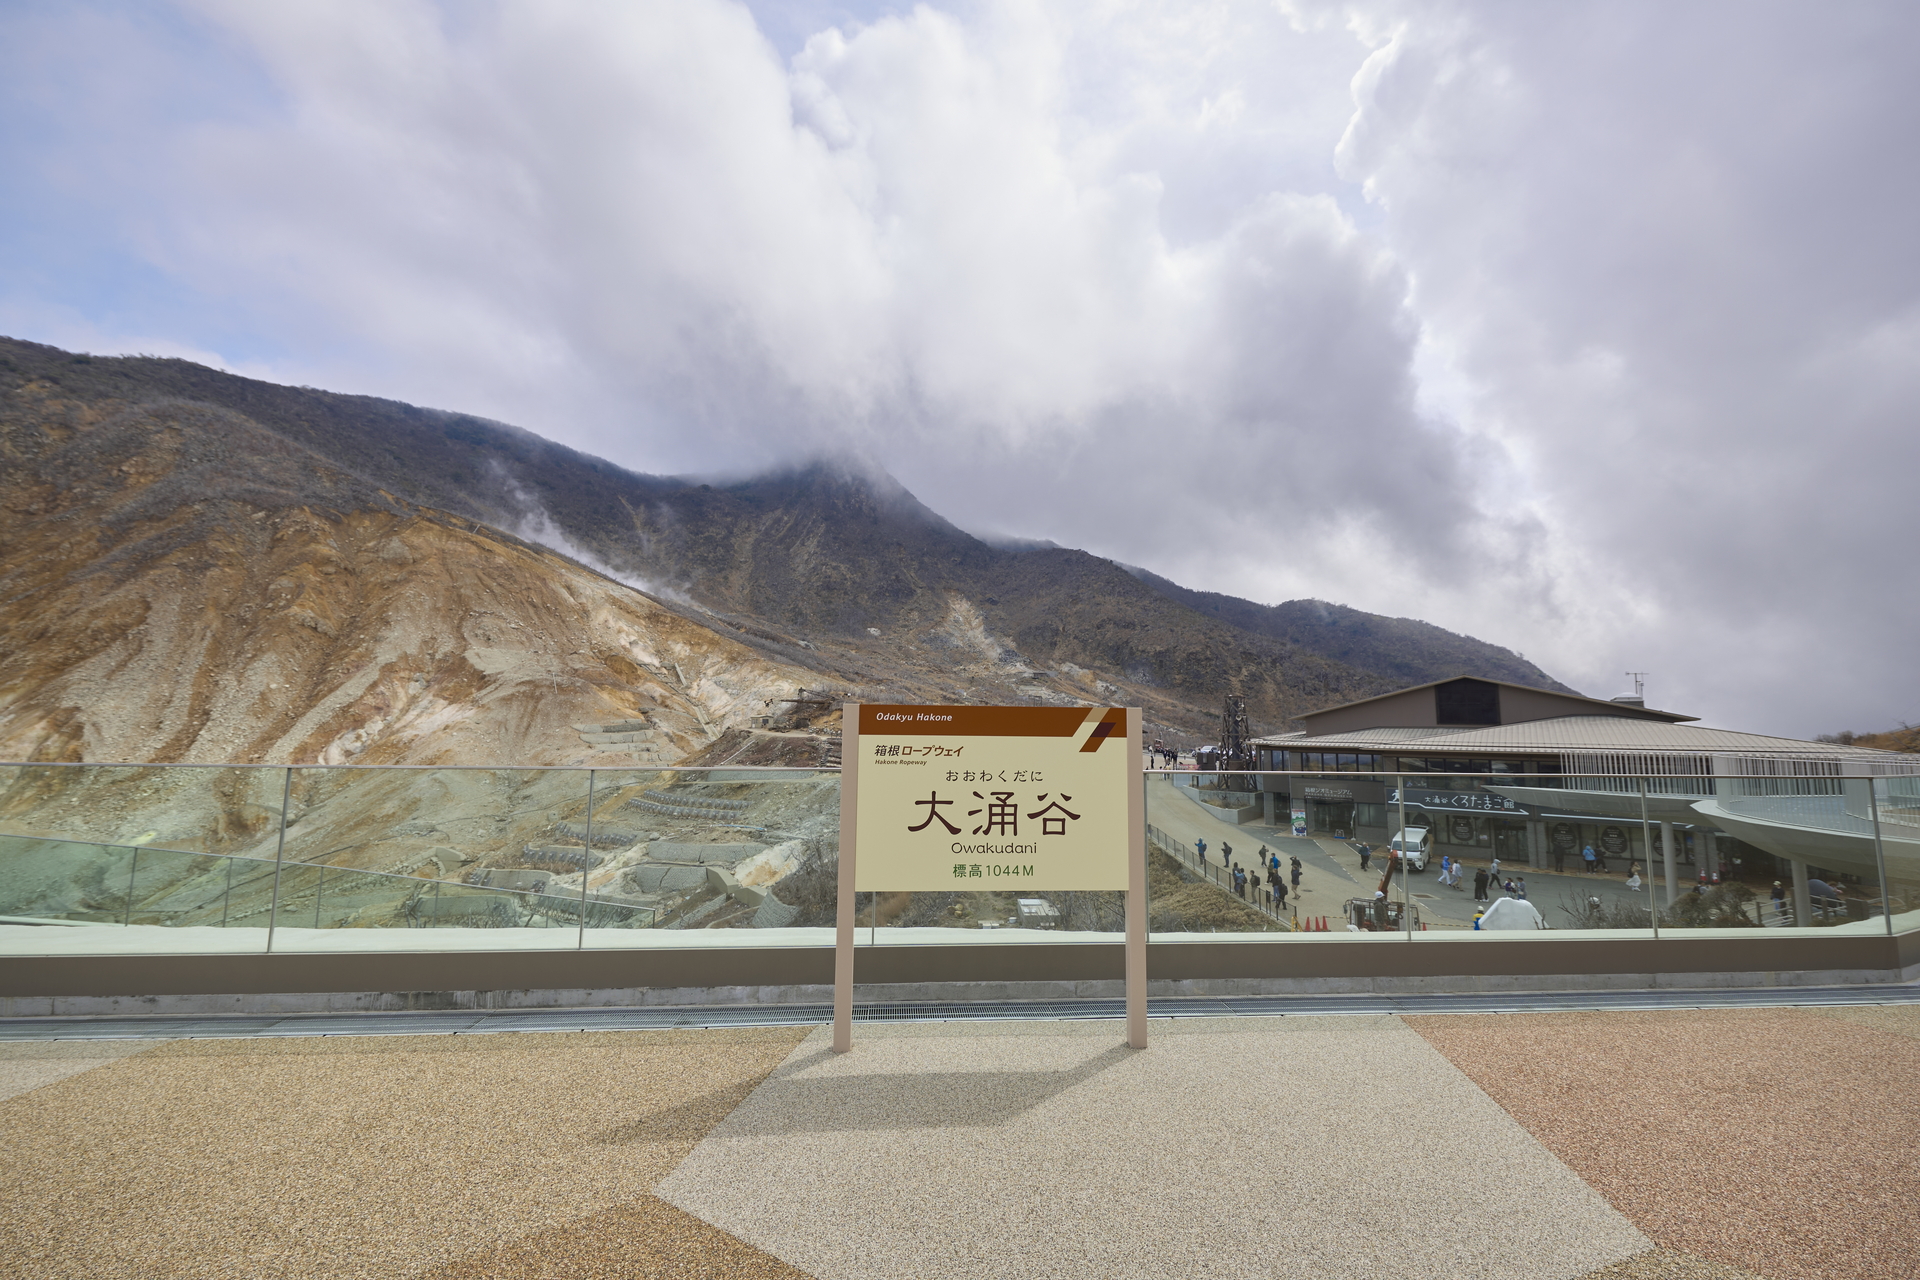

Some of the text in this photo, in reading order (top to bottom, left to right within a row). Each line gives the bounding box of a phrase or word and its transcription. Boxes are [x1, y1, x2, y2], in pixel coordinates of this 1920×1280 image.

[876, 712, 953, 722] Odakyu Hakone
[874, 745, 964, 757] 箱根ロープウェイ
[945, 770, 1043, 782] おおわくだに
[907, 790, 1081, 836] 大涌谷
[951, 842, 1037, 854] Owakudani
